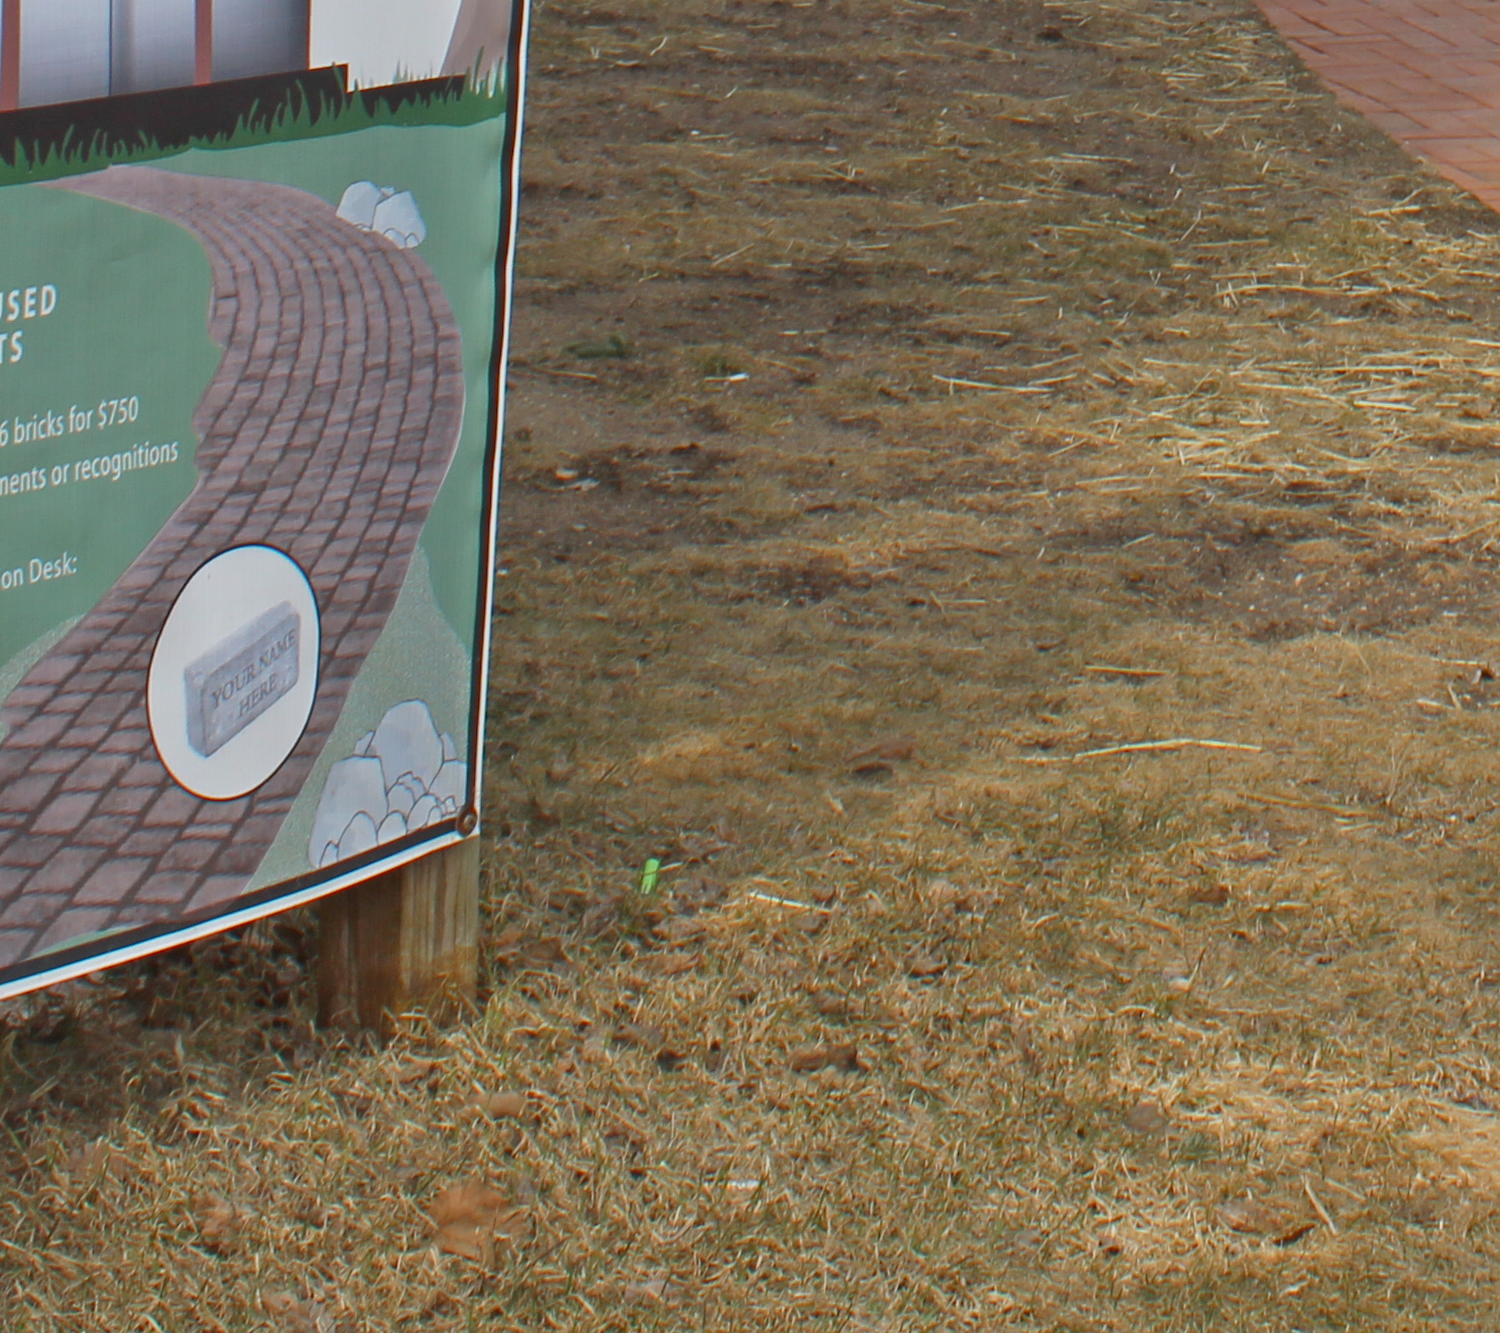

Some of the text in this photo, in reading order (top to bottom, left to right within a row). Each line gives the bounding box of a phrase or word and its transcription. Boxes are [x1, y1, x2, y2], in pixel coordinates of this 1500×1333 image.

[13, 410, 64, 445] bricks
[68, 404, 93, 434] for
[98, 396, 140, 430] $750
[51, 462, 71, 486] or
[74, 440, 180, 482] recognitions
[29, 551, 79, 584] Desk:
[211, 628, 296, 710] YOUR NAME
[237, 673, 278, 718] HERE
